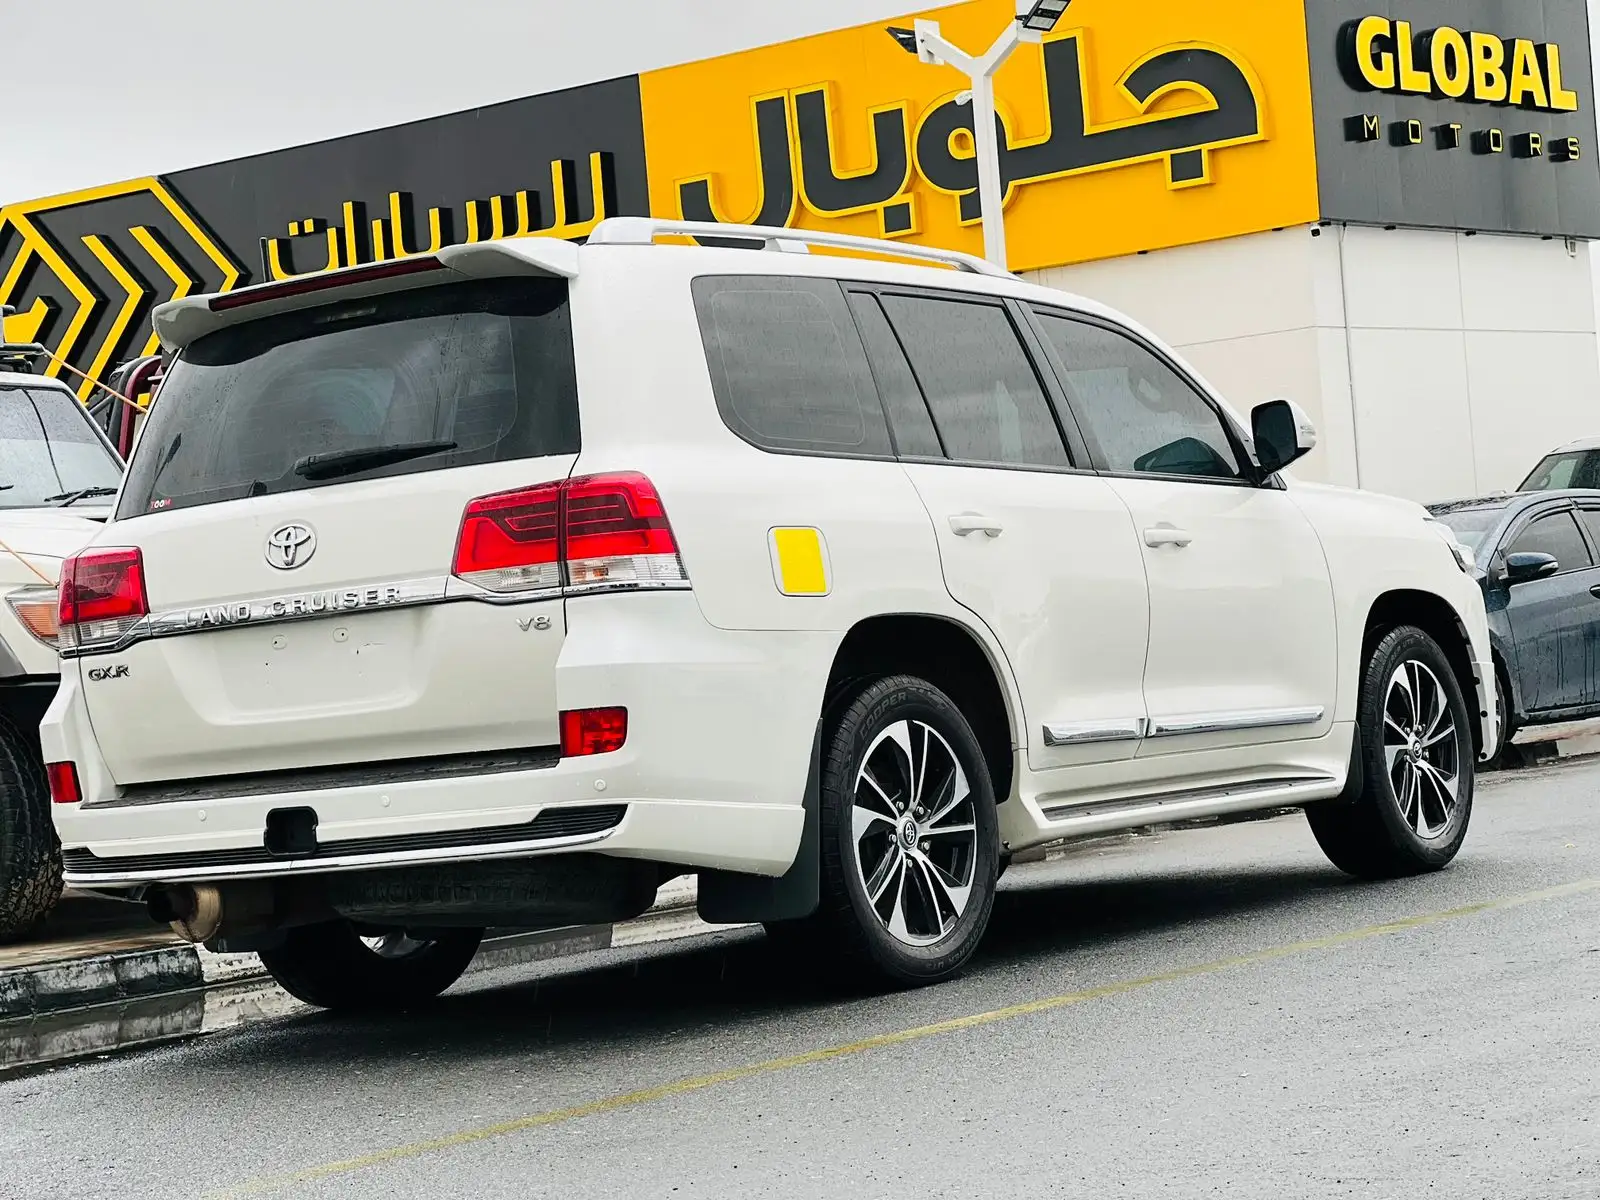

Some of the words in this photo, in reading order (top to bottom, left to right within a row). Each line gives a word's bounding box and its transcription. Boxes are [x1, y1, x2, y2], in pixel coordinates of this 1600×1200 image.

[1354, 15, 1579, 111] GLOBAL
[675, 29, 1267, 250] جلوبال
[1361, 113, 1581, 161] MOTORS
[184, 603, 251, 626] LAND
[271, 586, 401, 617] CRUISER
[515, 614, 552, 632] V8
